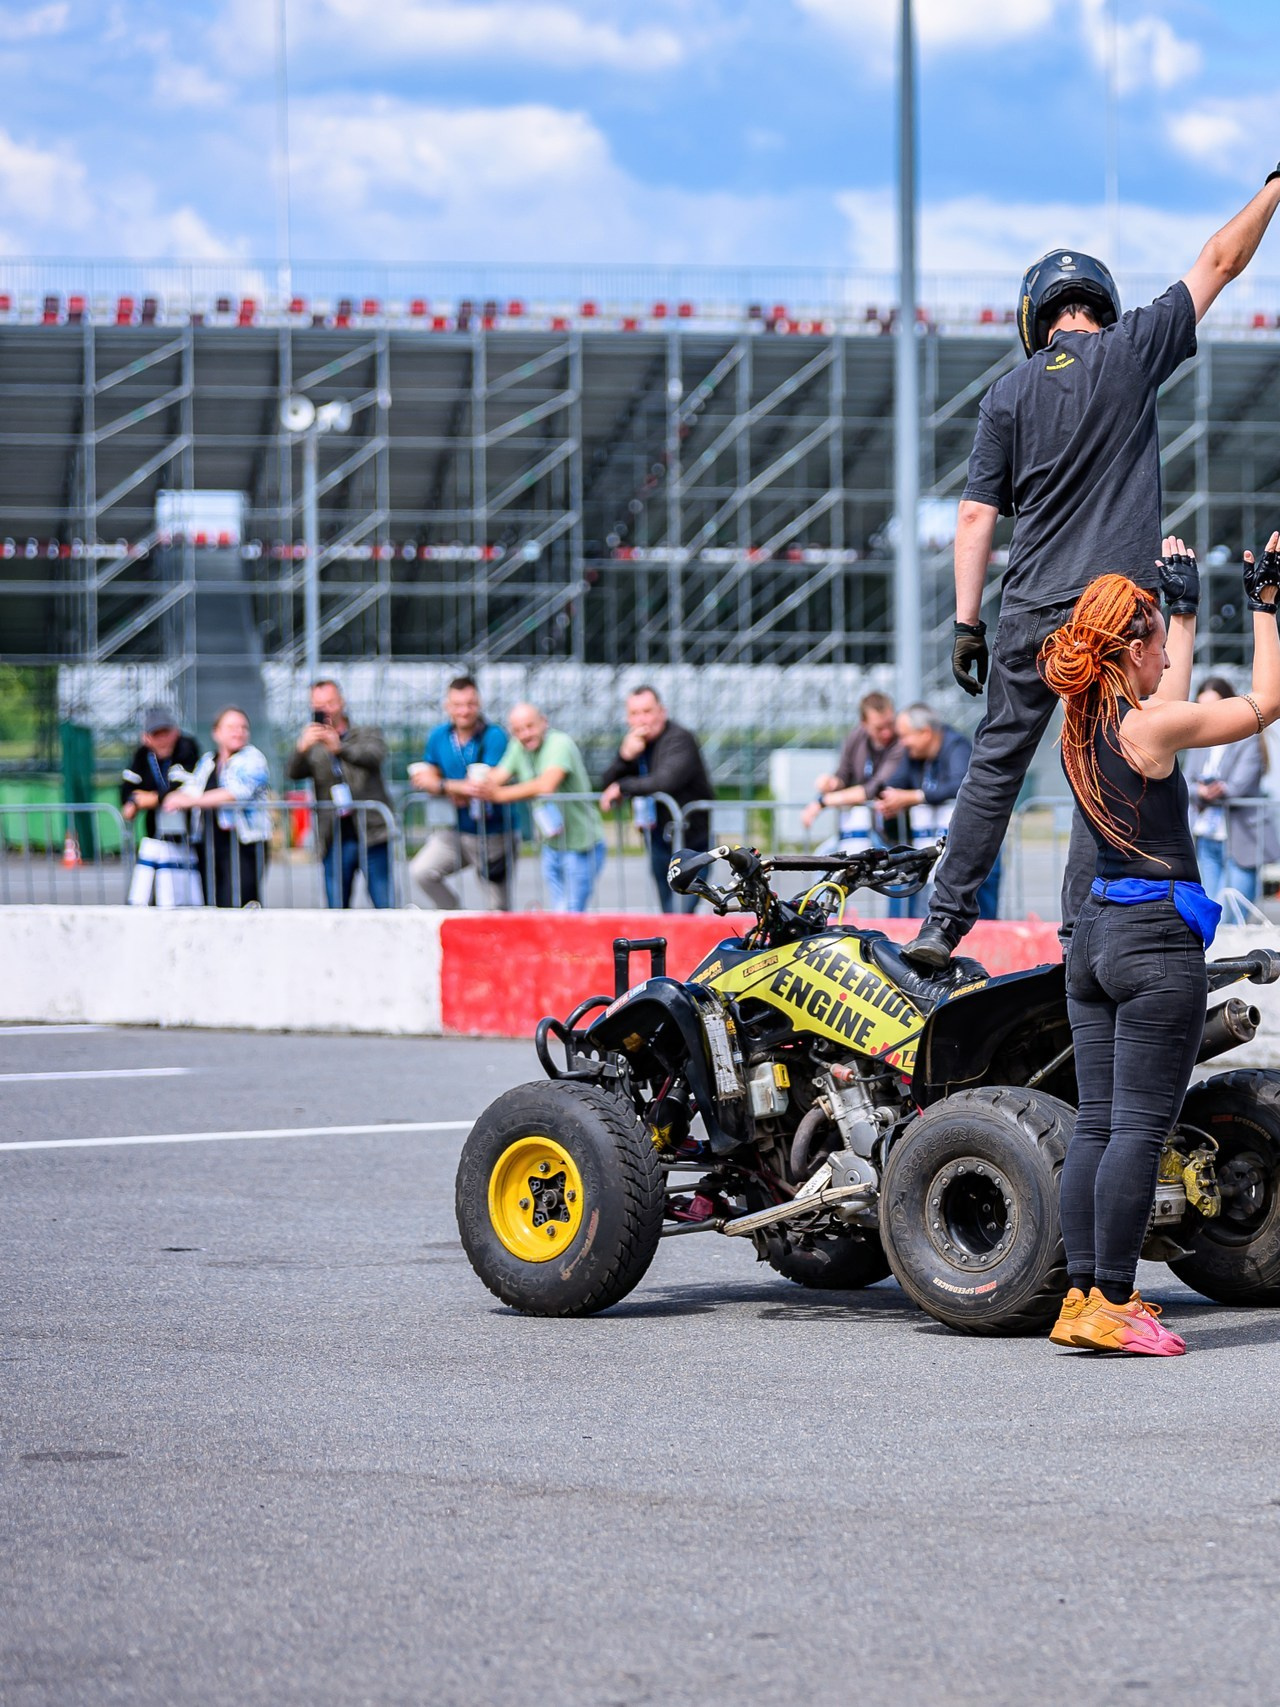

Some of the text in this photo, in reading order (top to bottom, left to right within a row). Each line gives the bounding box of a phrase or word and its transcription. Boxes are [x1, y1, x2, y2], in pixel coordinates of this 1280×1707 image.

[770, 968, 876, 1048] ENGINE
[793, 939, 919, 1029] FREERIDE
[932, 1277, 975, 1294] SPEEDRACER
